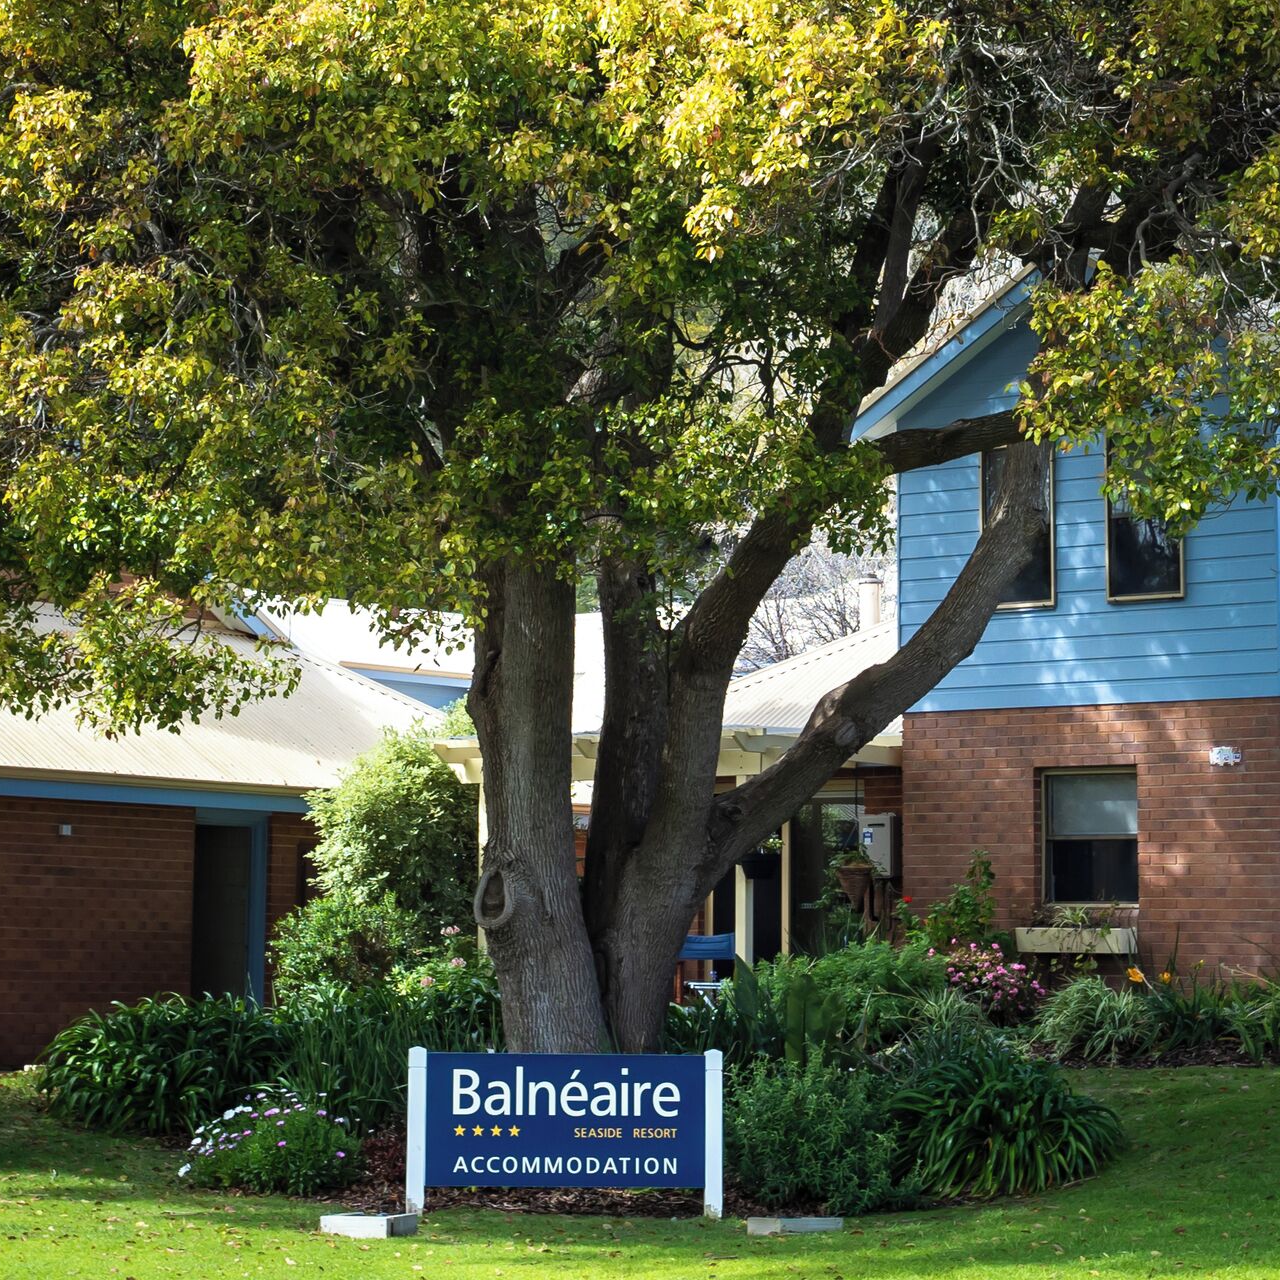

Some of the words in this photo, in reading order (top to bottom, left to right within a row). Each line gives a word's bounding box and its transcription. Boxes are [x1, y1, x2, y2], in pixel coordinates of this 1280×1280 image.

[452, 1066, 681, 1118] Balnéaire
[574, 1127, 622, 1138] SEASIDE
[633, 1128, 678, 1139] RESORT
[453, 1156, 677, 1175] ACCOMMODATION
